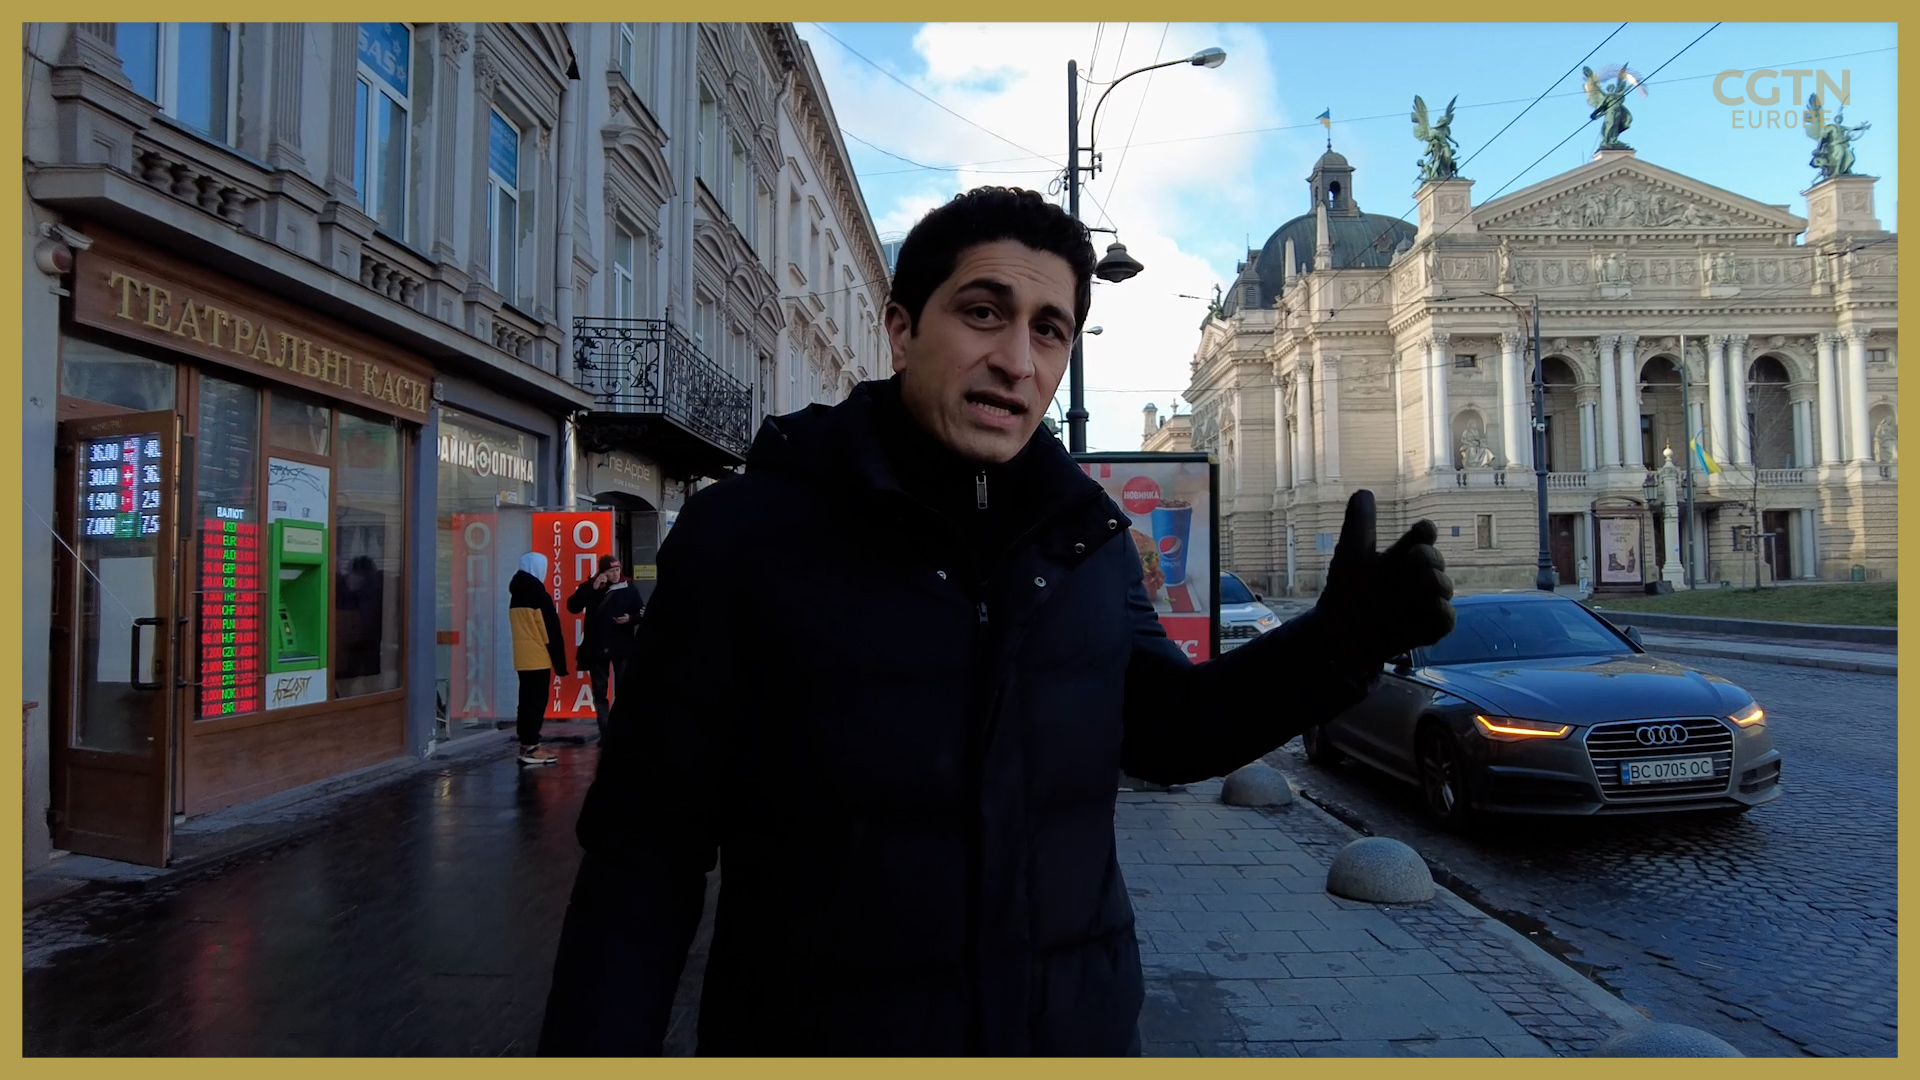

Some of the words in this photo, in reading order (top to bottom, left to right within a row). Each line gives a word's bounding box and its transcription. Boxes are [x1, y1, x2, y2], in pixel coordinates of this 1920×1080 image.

[110, 271, 353, 389] ТЕАТРАЛЬНІ
[360, 361, 427, 414] КАСИ
[90, 443, 119, 462] 36.00
[437, 435, 475, 469] АЙНА
[491, 450, 534, 483] ОПТИКА
[88, 467, 118, 486] 30.00
[87, 491, 117, 511] 1.500
[1123, 490, 1160, 500] НОВИНКА
[216, 506, 245, 520] ВАЛЮТ
[86, 516, 116, 535] 7.000
[223, 534, 236, 546] EUR
[223, 549, 235, 561] AUD
[222, 562, 235, 574] GBP
[222, 576, 235, 588] CAD
[222, 604, 235, 616] CHF
[222, 618, 235, 630] PLN
[222, 632, 235, 644] HUF
[222, 701, 235, 714] SAR
[1630, 765, 1651, 779] BC
[1654, 763, 1687, 778] 0705
[1690, 760, 1710, 775] OC
